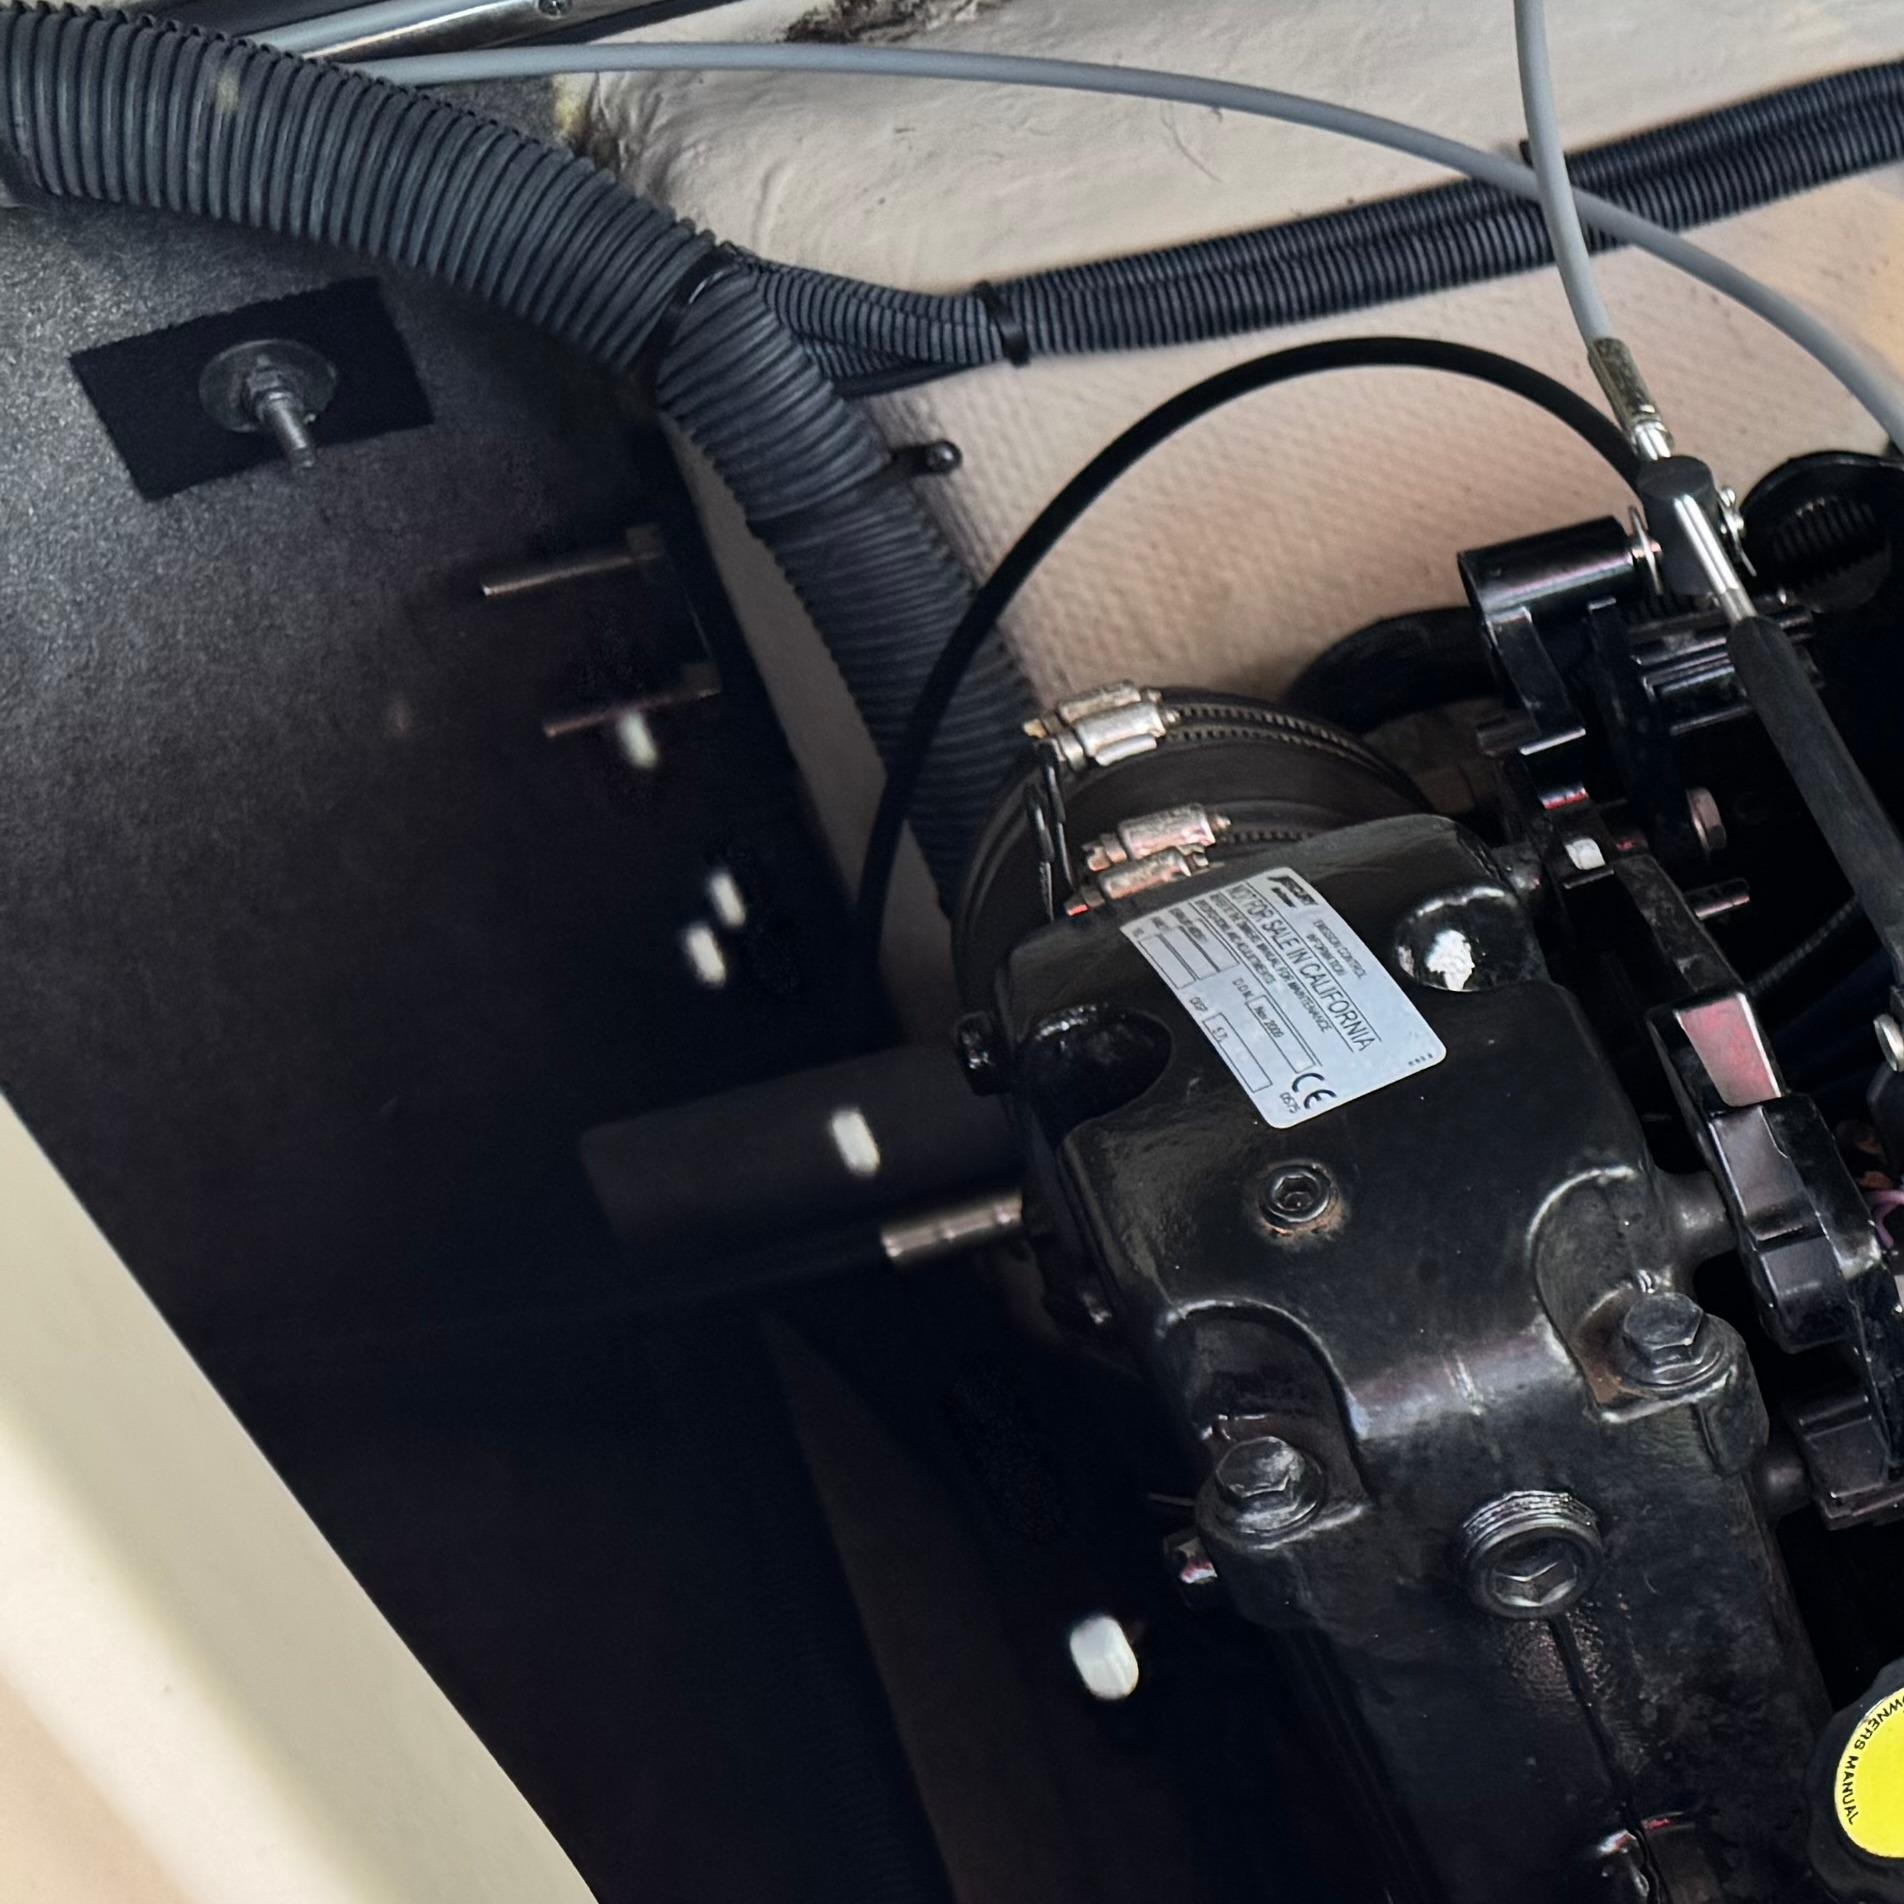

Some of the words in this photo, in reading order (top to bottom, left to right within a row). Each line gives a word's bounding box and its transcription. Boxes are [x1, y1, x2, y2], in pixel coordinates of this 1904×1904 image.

[1225, 883, 1259, 907] NOT
[1240, 900, 1274, 922] FOR
[1259, 918, 1302, 951] SALE
[1286, 945, 1313, 965] IN
[1305, 933, 1347, 977] INFORMATION
[1335, 946, 1368, 979] CONTROL
[1297, 960, 1377, 1053] CALIFORNIA
[1838, 1754, 1859, 1825] MANUAL
